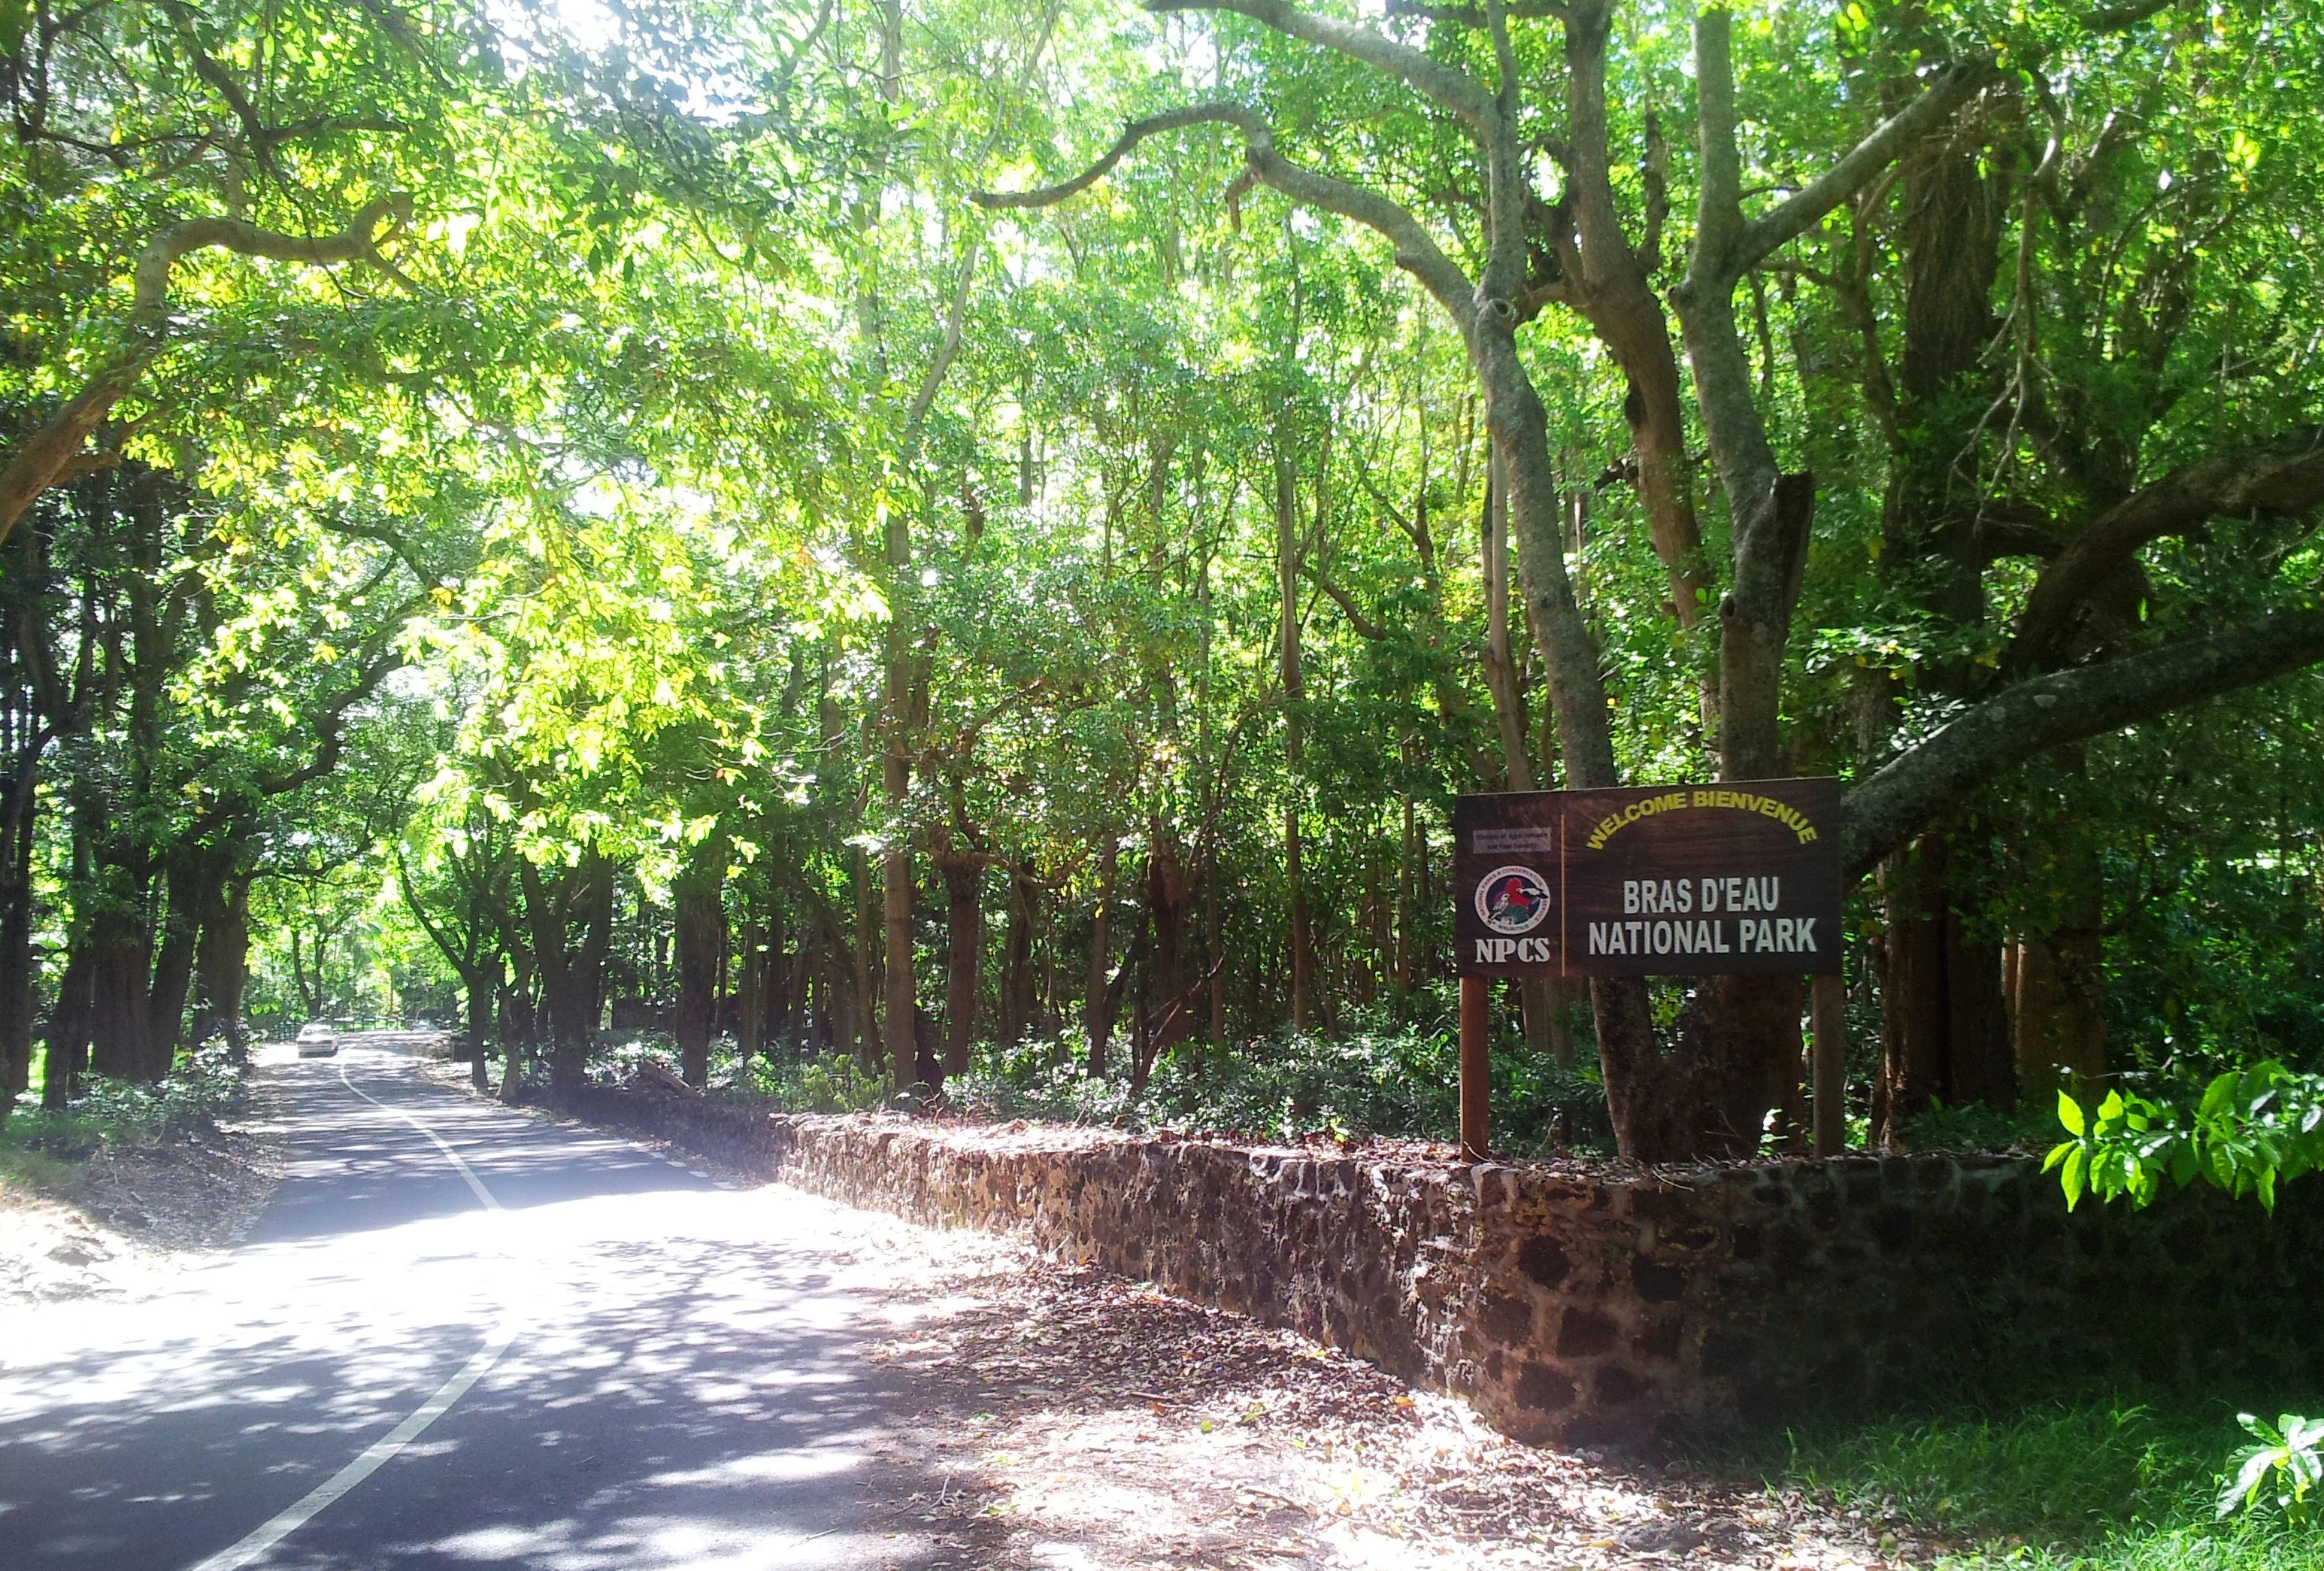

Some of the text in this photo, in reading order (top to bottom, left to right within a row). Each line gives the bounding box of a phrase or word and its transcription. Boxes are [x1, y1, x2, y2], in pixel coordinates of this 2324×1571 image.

[1586, 790, 1818, 851] WELCOME BIENVENUE
[1623, 875, 1779, 914] BRAS D'EAU
[1474, 937, 1551, 963] NPCS
[1589, 917, 1819, 955] NATIONAL PARK
